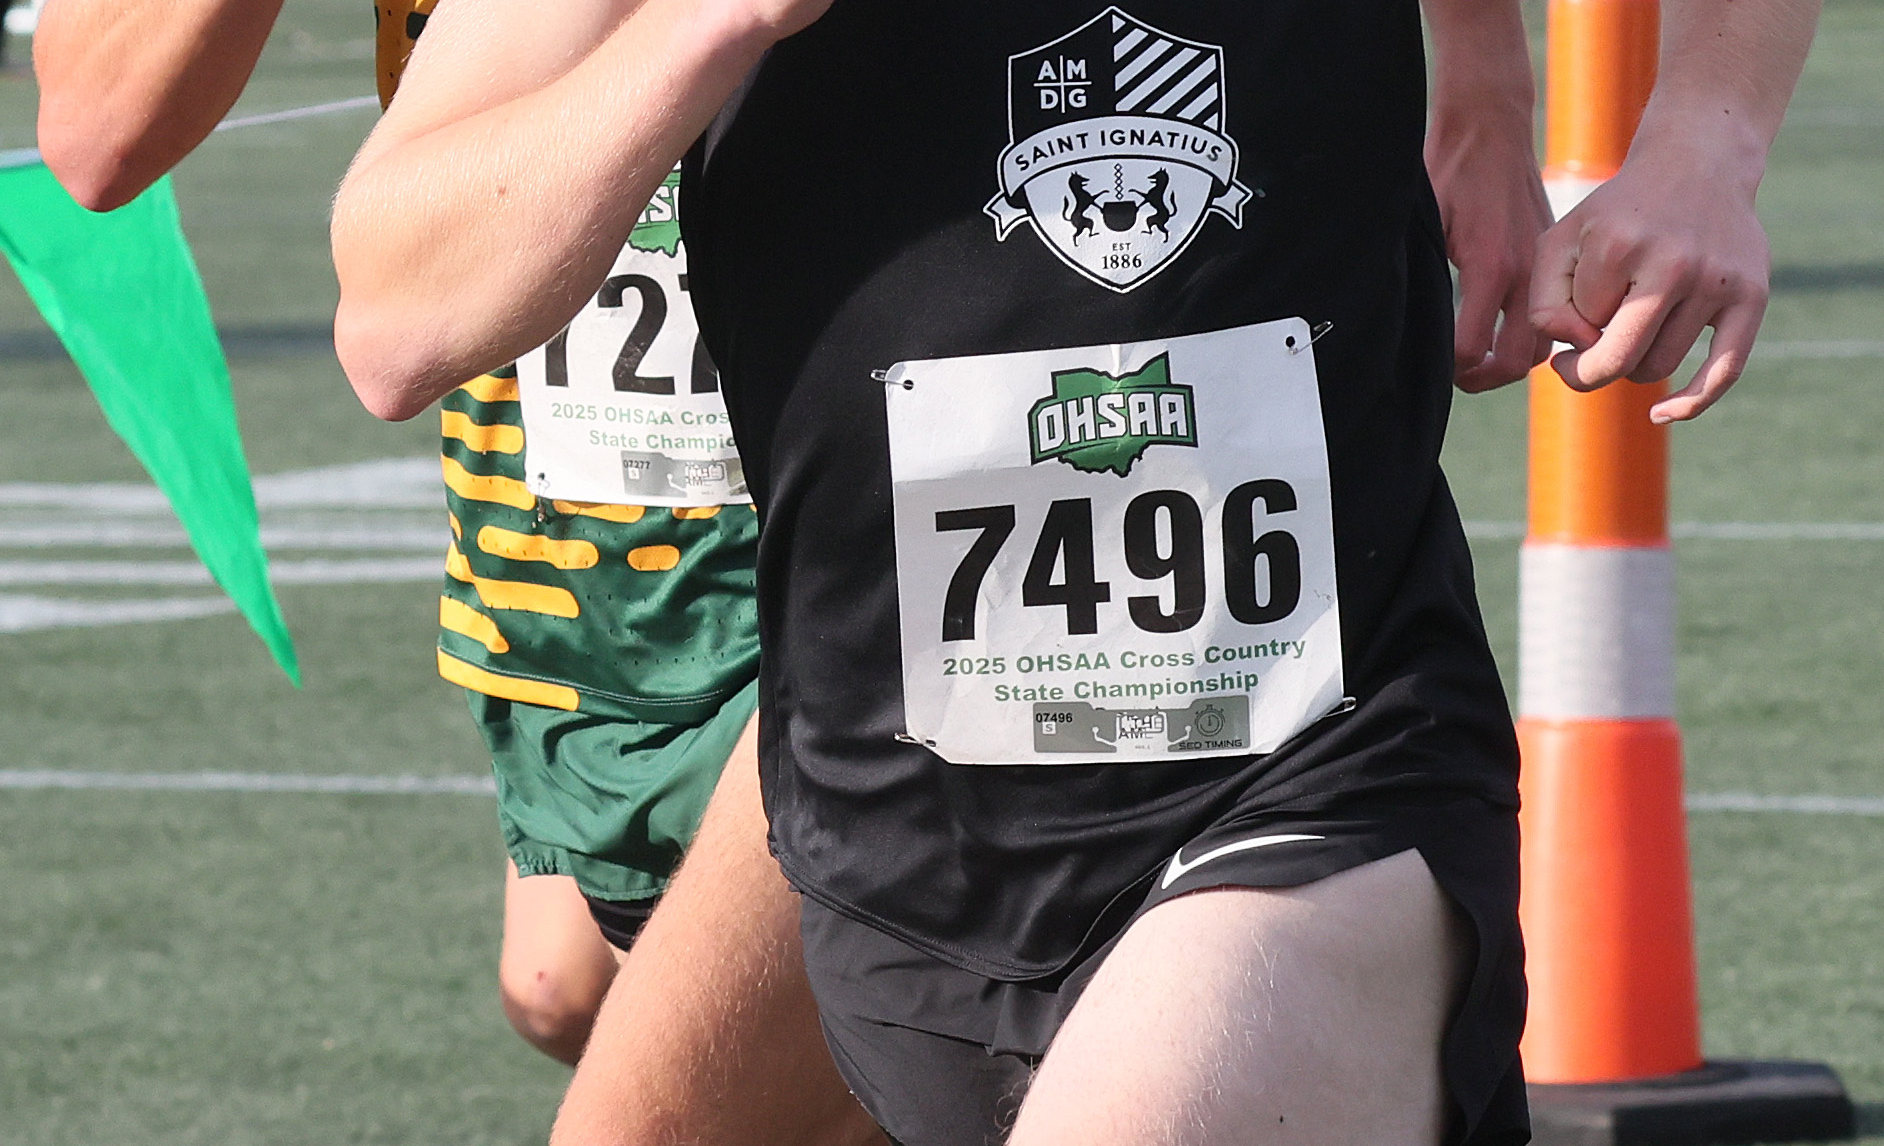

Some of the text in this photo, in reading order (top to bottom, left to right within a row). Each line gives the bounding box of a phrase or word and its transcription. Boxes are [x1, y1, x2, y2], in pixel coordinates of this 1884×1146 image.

[1014, 129, 1223, 172] SAINT IGNATIUS
[1112, 242, 1132, 252] EST
[1101, 254, 1143, 270] 1886
[551, 403, 731, 426] 2025 OHSAA Cros
[1036, 390, 1190, 454] OHSAA
[589, 430, 737, 453] State Champio
[934, 478, 1302, 643] 7496
[942, 638, 1306, 676] 2025 OHSAA Cross Country
[993, 669, 1260, 702] State Championship
[1035, 712, 1073, 724] 07496
[1204, 738, 1243, 749] TIMING
